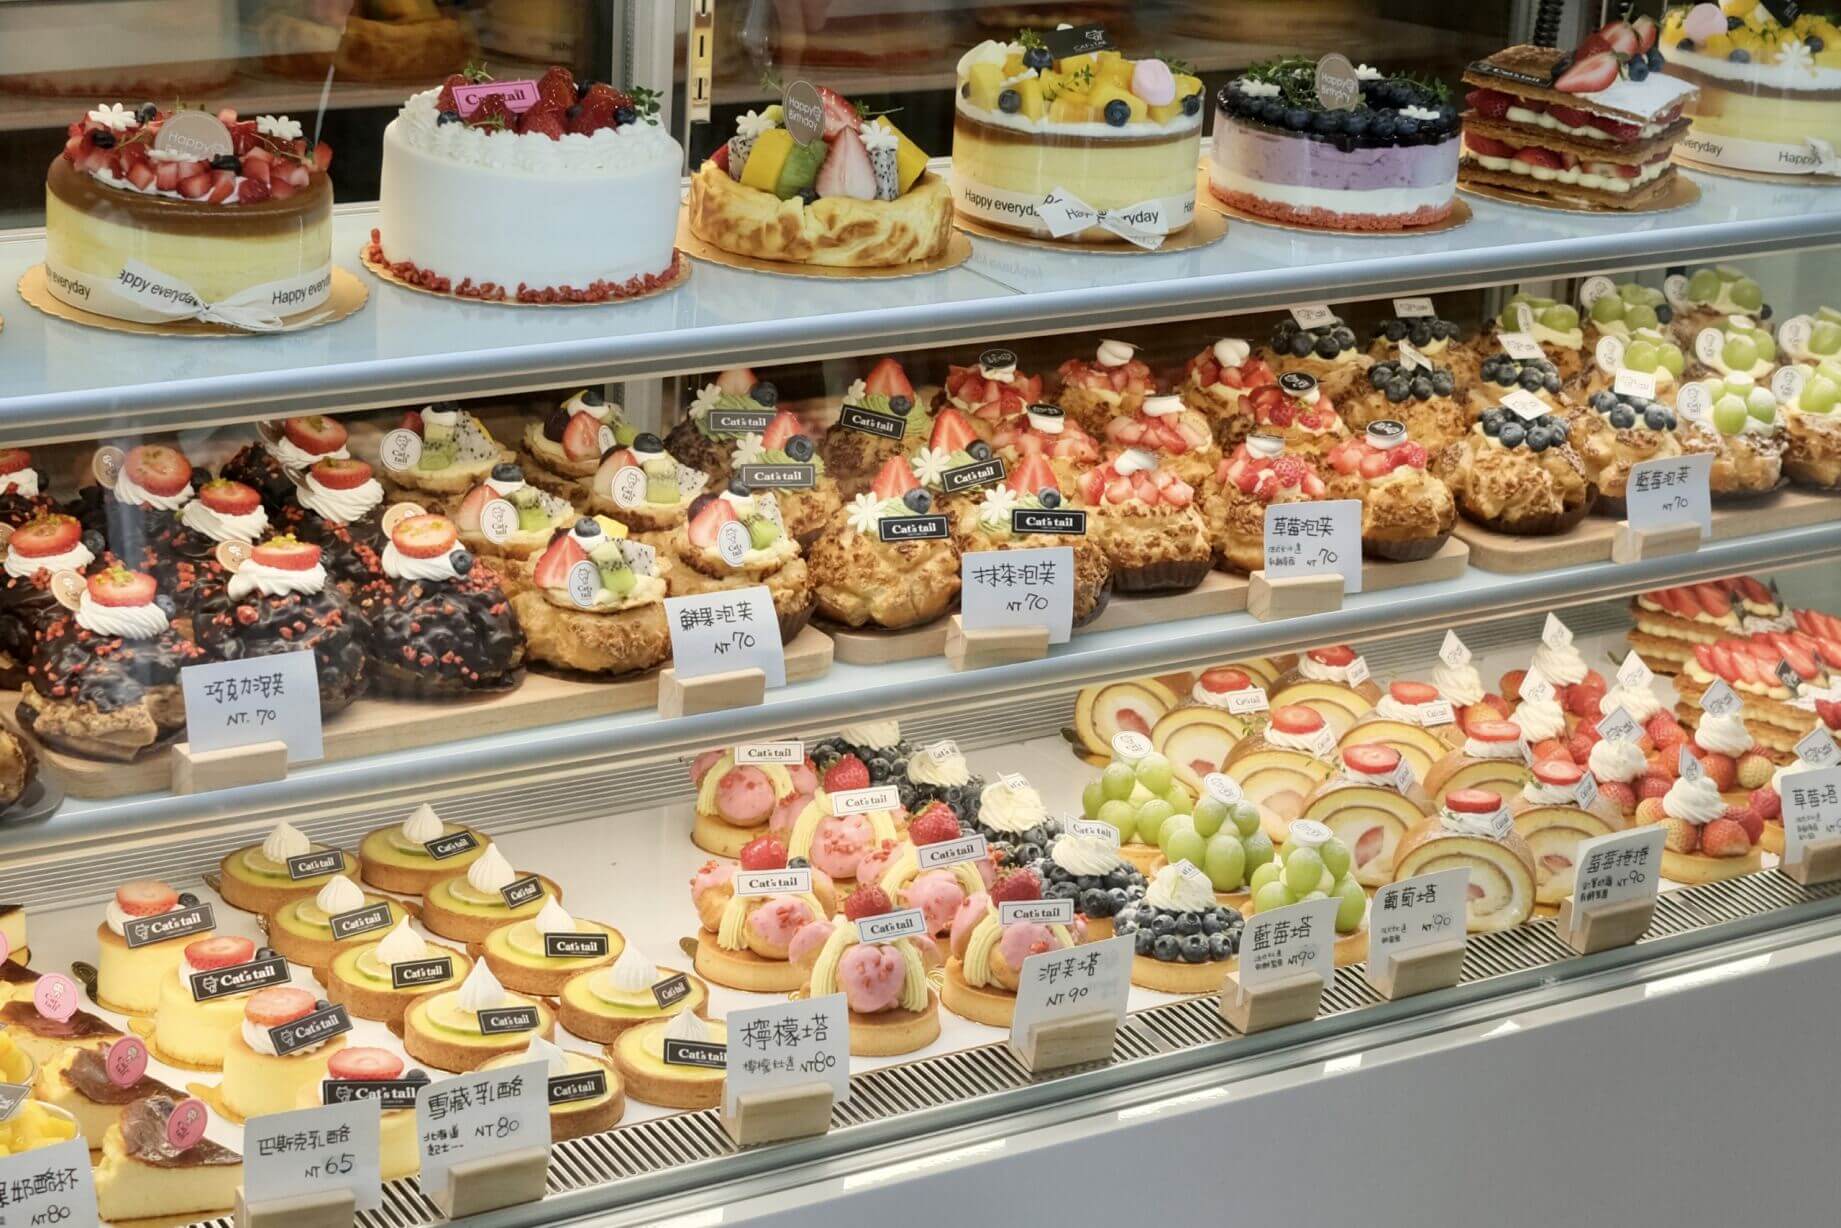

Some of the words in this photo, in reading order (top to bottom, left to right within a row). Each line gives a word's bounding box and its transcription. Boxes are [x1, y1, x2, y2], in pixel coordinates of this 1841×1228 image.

[789, 97, 813, 116] Happy
[788, 111, 817, 131] Birthday
[965, 188, 993, 210] Happy
[272, 288, 307, 306] Happy
[721, 417, 746, 426] Cat's
[748, 417, 767, 426] tail
[852, 415, 875, 427] Cat's
[876, 421, 894, 432] tail
[754, 472, 781, 481] Cat's
[782, 472, 802, 481] tail
[954, 471, 976, 484] Cat's
[977, 466, 995, 477] tail
[1663, 503, 1673, 512] NT
[1674, 496, 1688, 509] 70
[892, 524, 918, 535] Cat's
[918, 522, 936, 533] tail
[1025, 517, 1053, 527] Cat's
[1053, 517, 1073, 527] tail
[1272, 516, 1334, 537] 草莓泡芙
[1319, 548, 1338, 565] 70
[972, 560, 1056, 587] 抹茶泡芙
[1006, 601, 1022, 611] NT
[1025, 593, 1048, 610] 70
[680, 600, 754, 631] 鮮果泡芙
[714, 642, 731, 654] NT
[733, 631, 755, 649] 70
[205, 672, 284, 703] 巧克力泡芙
[256, 709, 277, 725] 70
[748, 748, 773, 758] Cat's
[774, 748, 791, 758] tail
[845, 797, 870, 808] Cat's
[870, 794, 888, 804] tail
[1792, 784, 1838, 810] 草莓塔
[437, 842, 453, 854] Cat's
[453, 838, 470, 850] tail
[930, 848, 954, 861] Cat's
[954, 844, 975, 856] tail
[298, 858, 319, 872] Cat's
[319, 856, 335, 868] tail
[749, 878, 776, 889] Cat's
[777, 876, 798, 887] tail
[1629, 870, 1646, 884] 90
[510, 886, 526, 901] Cat's
[525, 884, 537, 896] tail
[1384, 883, 1437, 910] 葡萄塔
[342, 918, 364, 931] Cat's
[364, 912, 382, 925] tail
[1013, 908, 1040, 919] Cat's
[1041, 908, 1061, 918] tail
[152, 917, 180, 934] Cat's
[180, 912, 202, 926] tail
[871, 923, 895, 934] Cat's
[895, 918, 914, 930] tail
[1253, 914, 1314, 952] 藍莓塔
[556, 941, 579, 952] Cat's
[580, 941, 598, 952] tail
[1039, 952, 1101, 984] 泡芙塔
[1299, 951, 1315, 968] 90
[221, 970, 253, 987] Cat's
[253, 965, 276, 979] tail
[403, 968, 426, 980] Cat's
[425, 965, 443, 977] tail
[1046, 993, 1065, 1007] NT
[1068, 987, 1088, 1003] 90
[295, 1021, 321, 1038] Cat's
[321, 1014, 340, 1029] tail
[490, 1015, 513, 1027] Cat's
[513, 1013, 530, 1025] tail
[740, 1013, 829, 1051] 檸檬塔
[678, 1048, 707, 1061] Cat's
[707, 1051, 727, 1063] tail
[800, 1061, 815, 1073] NT
[815, 1051, 836, 1073] 80
[355, 1087, 390, 1100] Cat's
[391, 1087, 417, 1099] tail
[428, 1075, 523, 1120] 雪藏乳酪
[553, 1084, 577, 1097] Cat's
[578, 1081, 596, 1094] tail
[475, 1124, 494, 1137] NT
[497, 1116, 519, 1138] 80
[257, 1123, 350, 1155] 巴斯克乳酪
[305, 1166, 320, 1178] NT
[325, 1152, 355, 1174] 65
[31, 1214, 46, 1226] NT
[47, 1204, 71, 1223] 80
